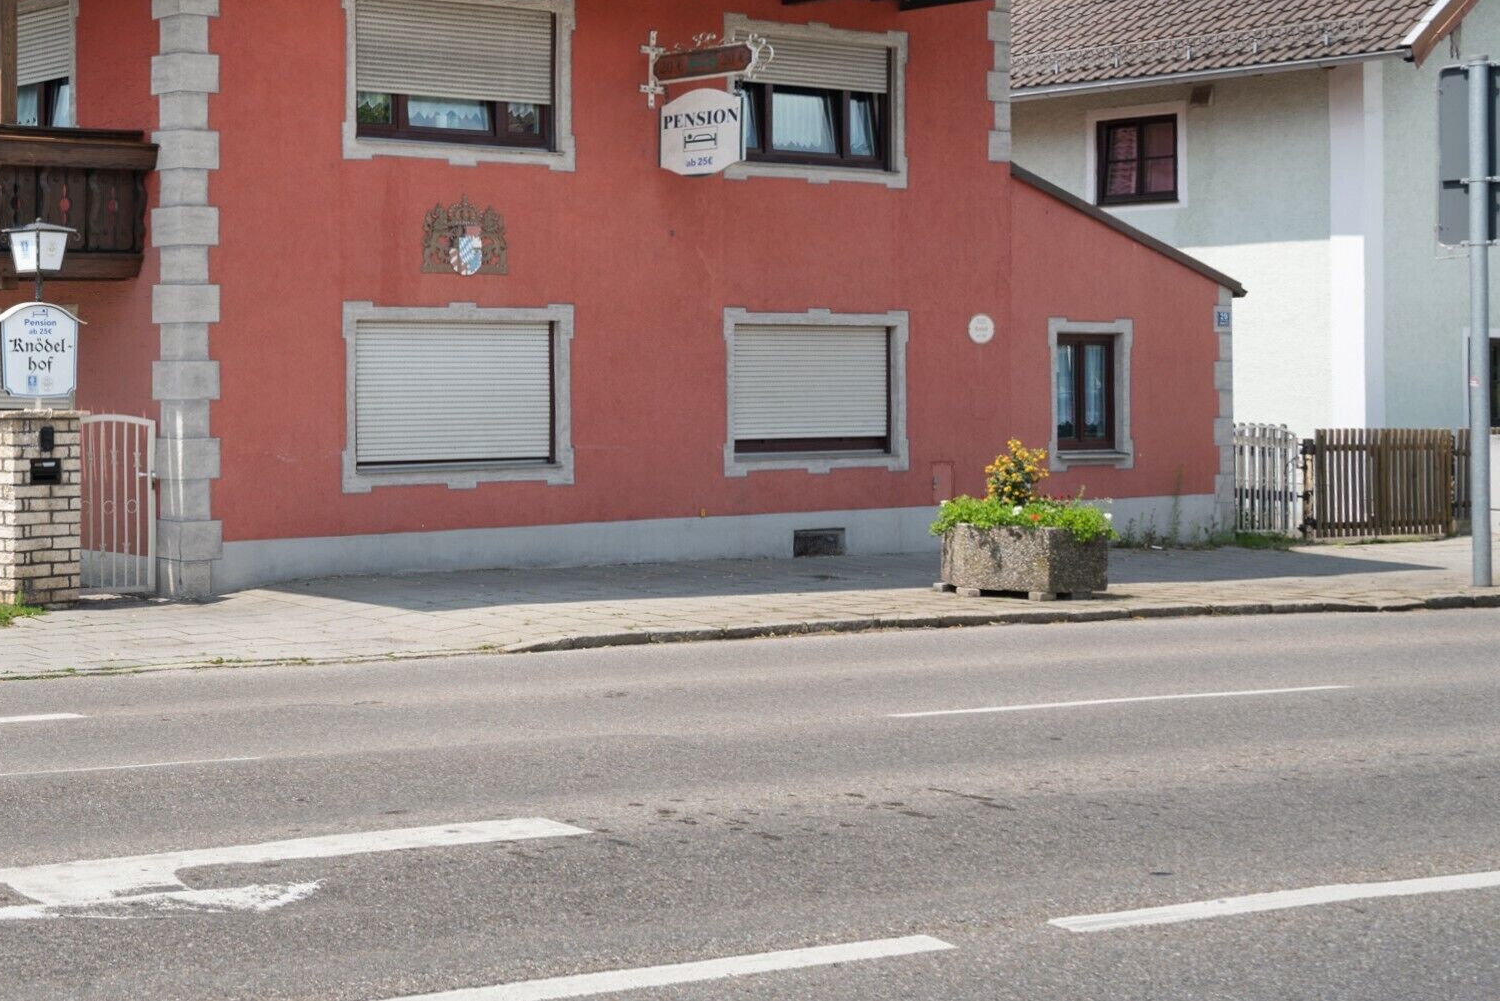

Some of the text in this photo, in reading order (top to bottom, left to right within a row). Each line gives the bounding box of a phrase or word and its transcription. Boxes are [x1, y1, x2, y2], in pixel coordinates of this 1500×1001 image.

[663, 107, 739, 130] PENSION
[686, 156, 713, 167] ab 25€
[24, 319, 57, 327] Pension
[9, 338, 73, 353] Knödel-
[28, 356, 54, 373] hof
